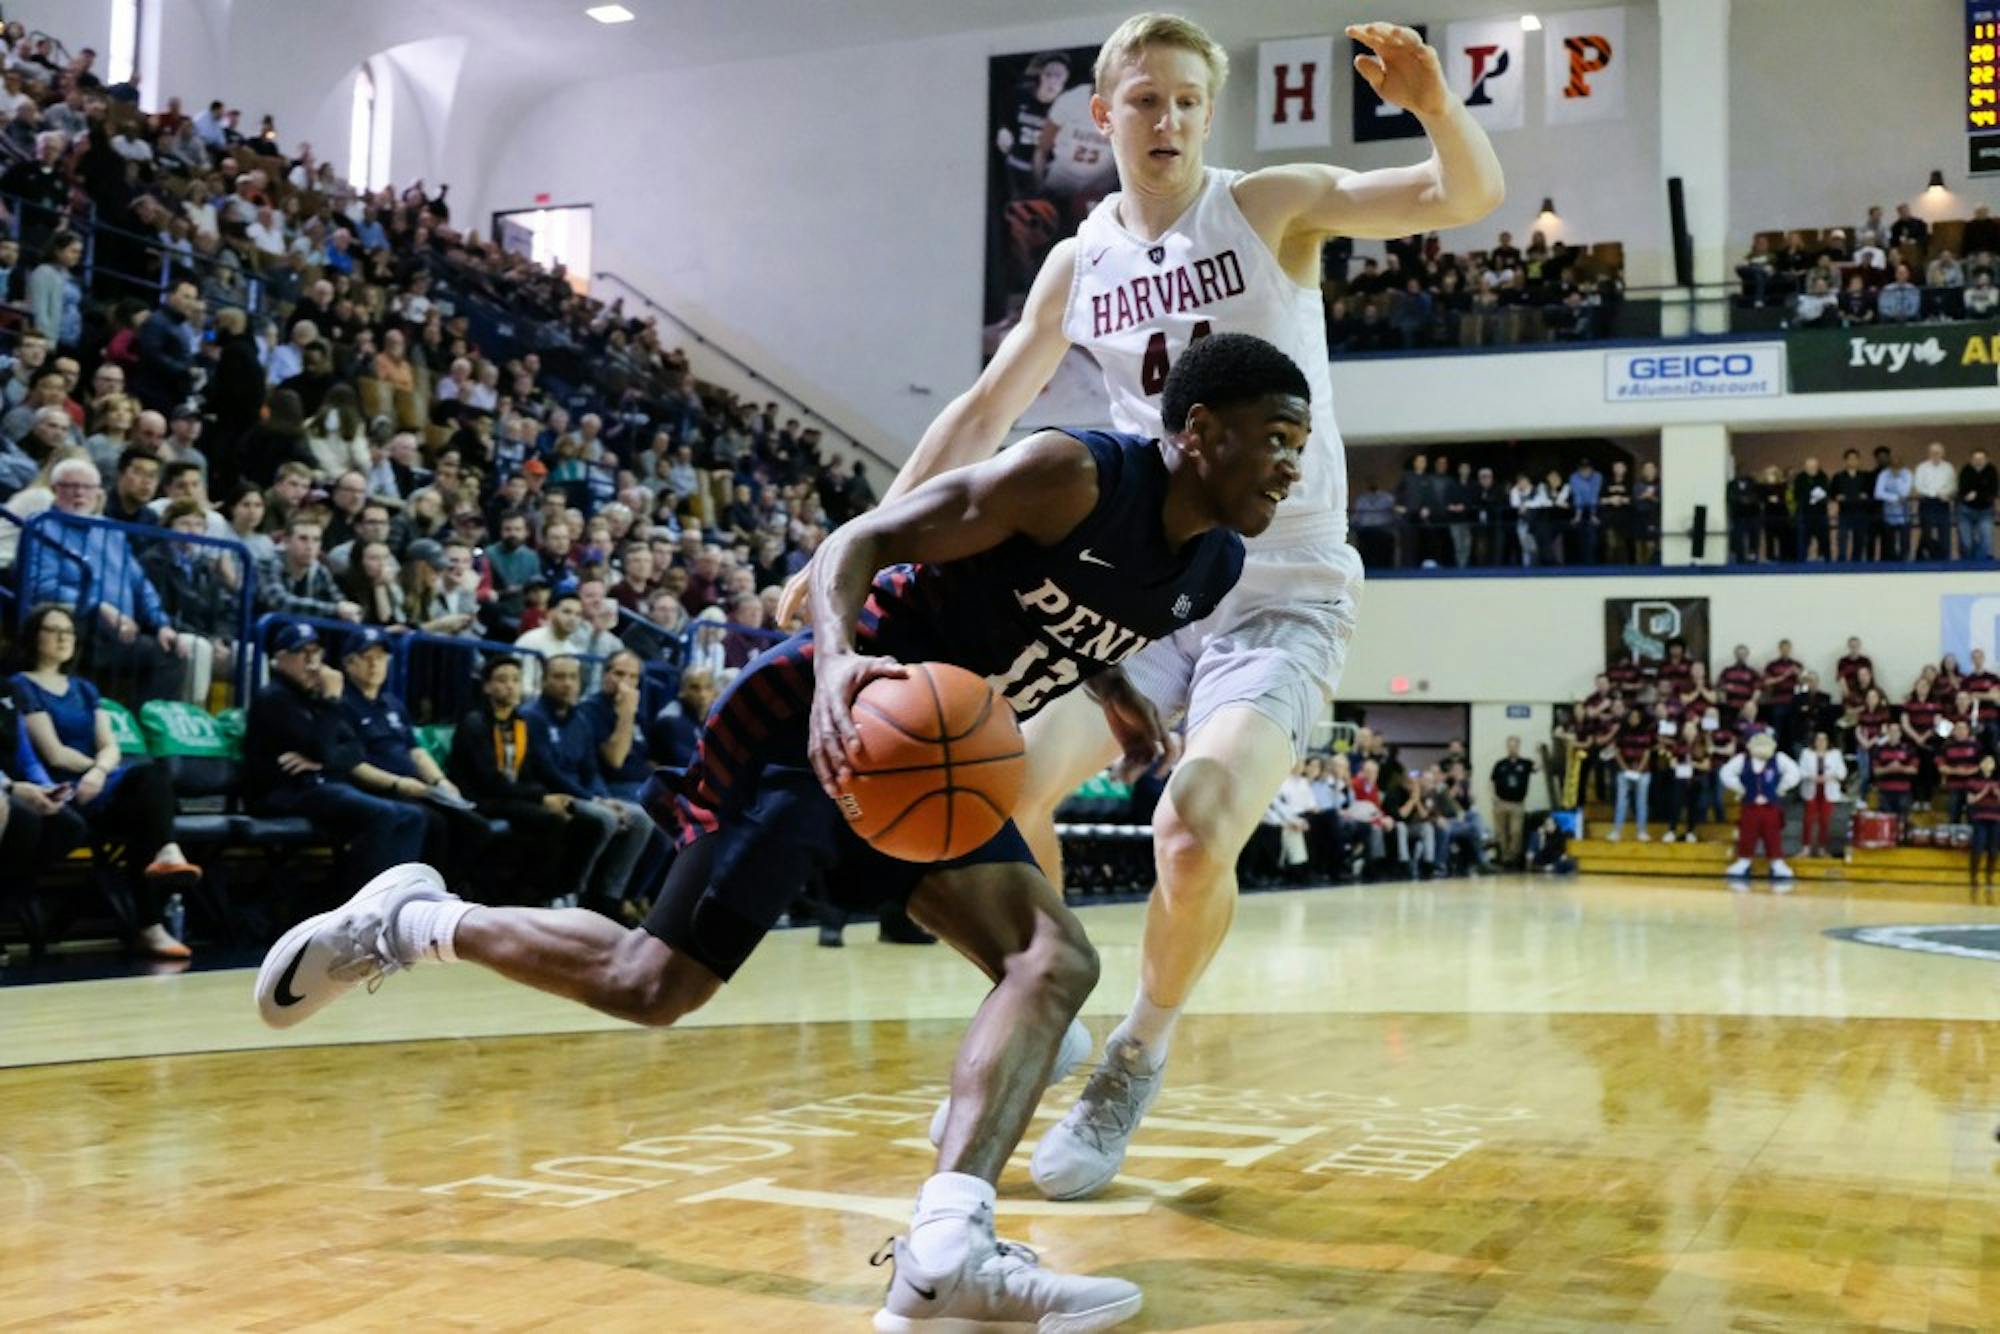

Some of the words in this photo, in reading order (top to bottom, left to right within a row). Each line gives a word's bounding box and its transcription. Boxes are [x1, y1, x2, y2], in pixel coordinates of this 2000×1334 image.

[1272, 64, 1317, 125] H
[1092, 250, 1246, 338] HARVARD
[1142, 320, 1212, 396] 4
[1629, 354, 1753, 380] GEICO
[1849, 337, 1912, 373] Ivy
[1617, 381, 1768, 397] #AlumniDiscount
